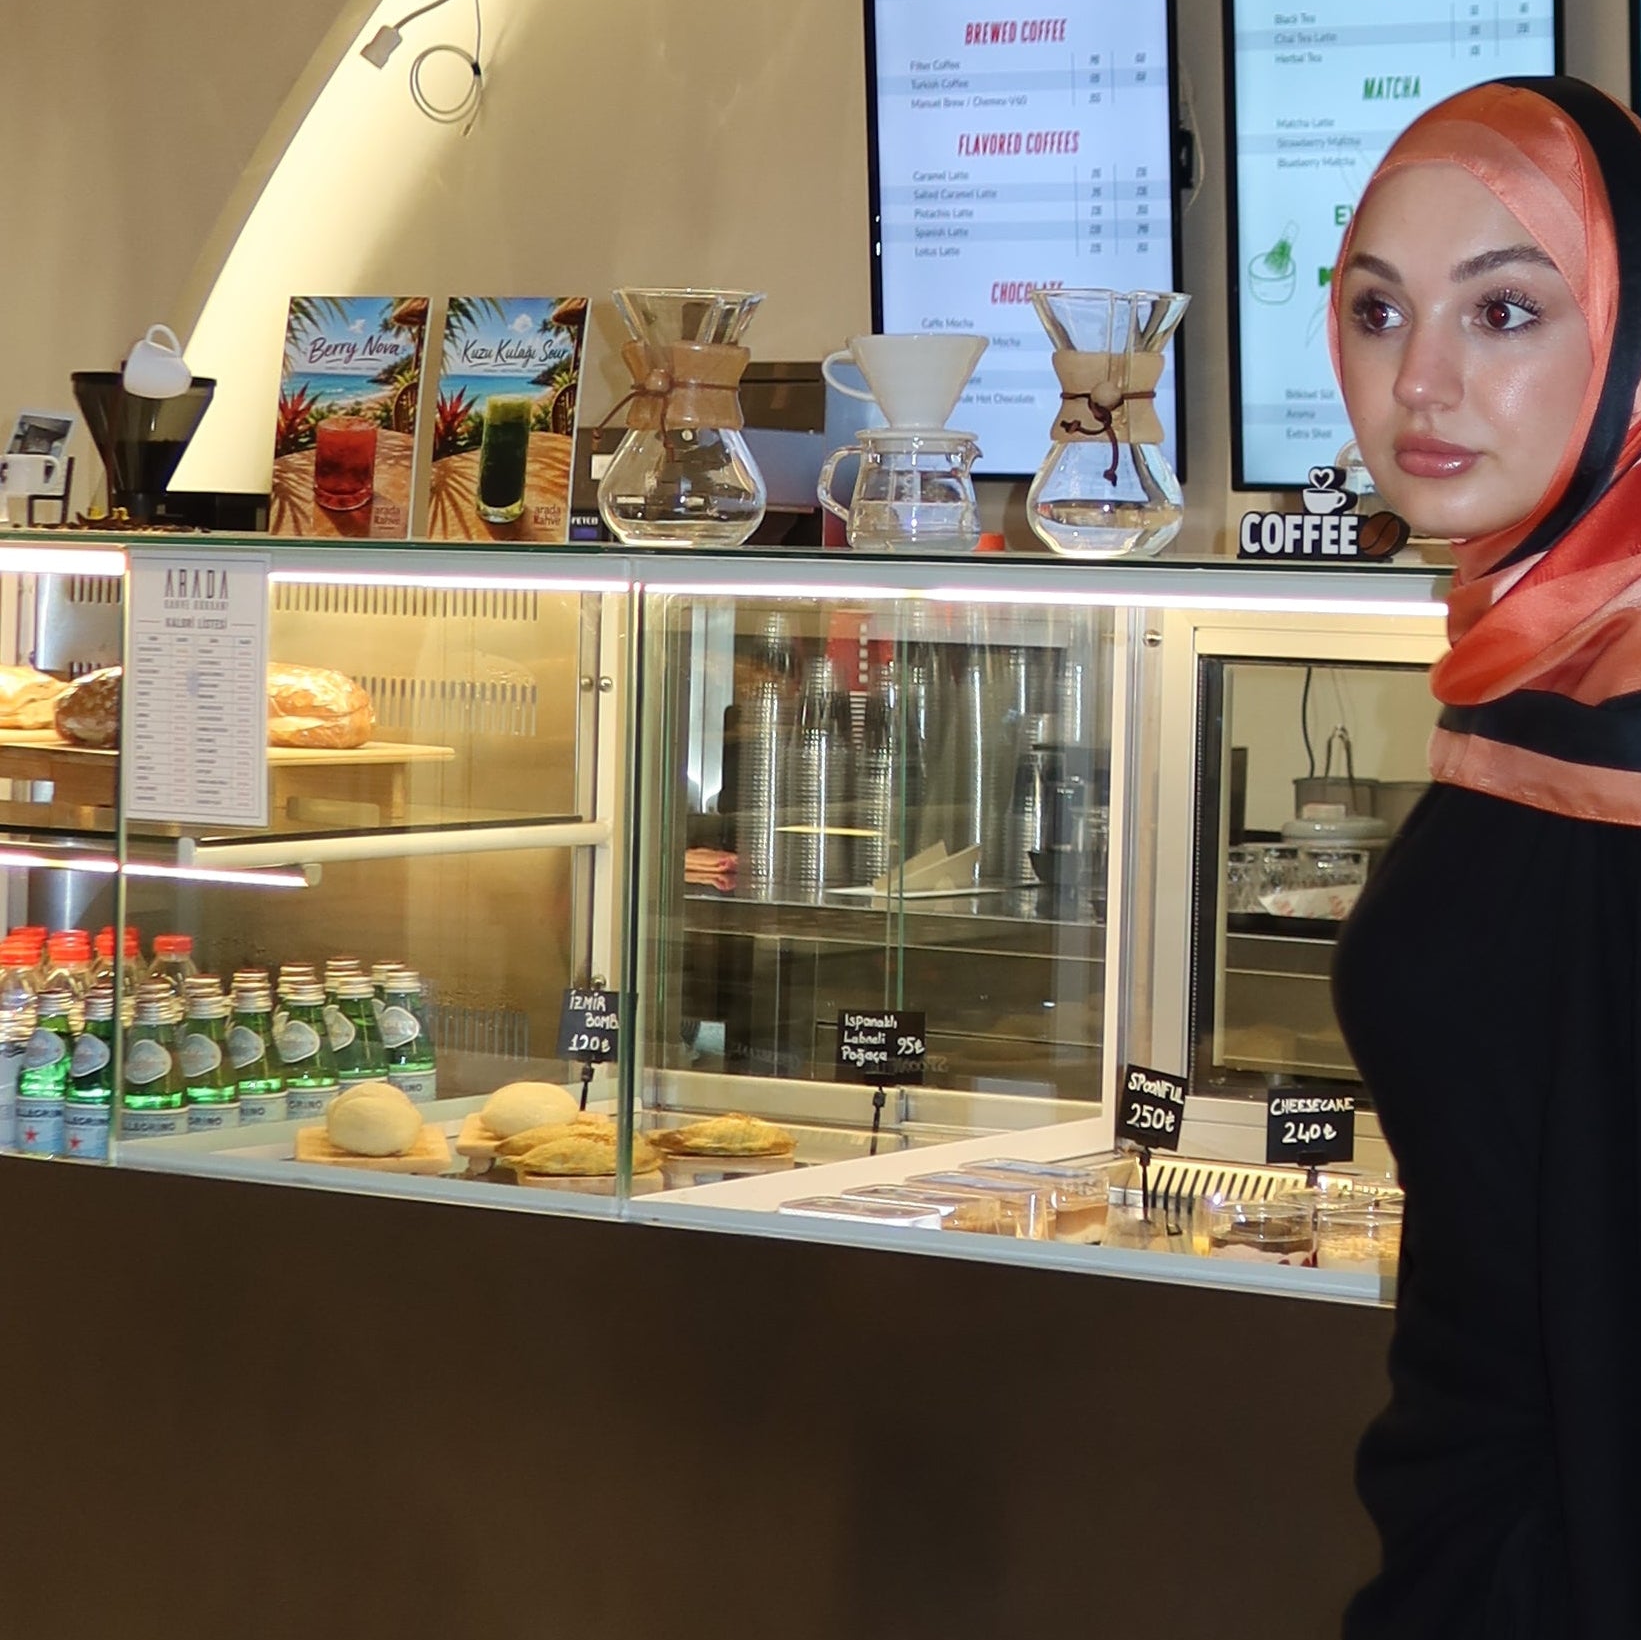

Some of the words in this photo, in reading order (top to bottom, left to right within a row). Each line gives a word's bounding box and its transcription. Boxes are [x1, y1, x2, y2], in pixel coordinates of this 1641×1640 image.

[965, 21, 1016, 45] BREWED
[1021, 18, 1067, 42] COFFEE
[1363, 77, 1420, 101] MATCHA
[958, 132, 1021, 156] FLAVORED
[1026, 130, 1079, 154] COFFEES
[308, 336, 357, 364] Berry
[362, 334, 400, 356] Nova
[462, 339, 492, 363] Kuzu
[495, 339, 536, 368] Kulağı
[539, 339, 568, 362] Sour
[1241, 514, 1358, 554] COFFEE
[569, 989, 606, 1012] İZMİR
[585, 1011, 620, 1030] BOMB
[843, 1030, 886, 1045] Labneli
[841, 1046, 888, 1067] Poğaça
[1128, 1072, 1184, 1105] SPOONFUL
[1270, 1096, 1354, 1117] CHEESECAKE
